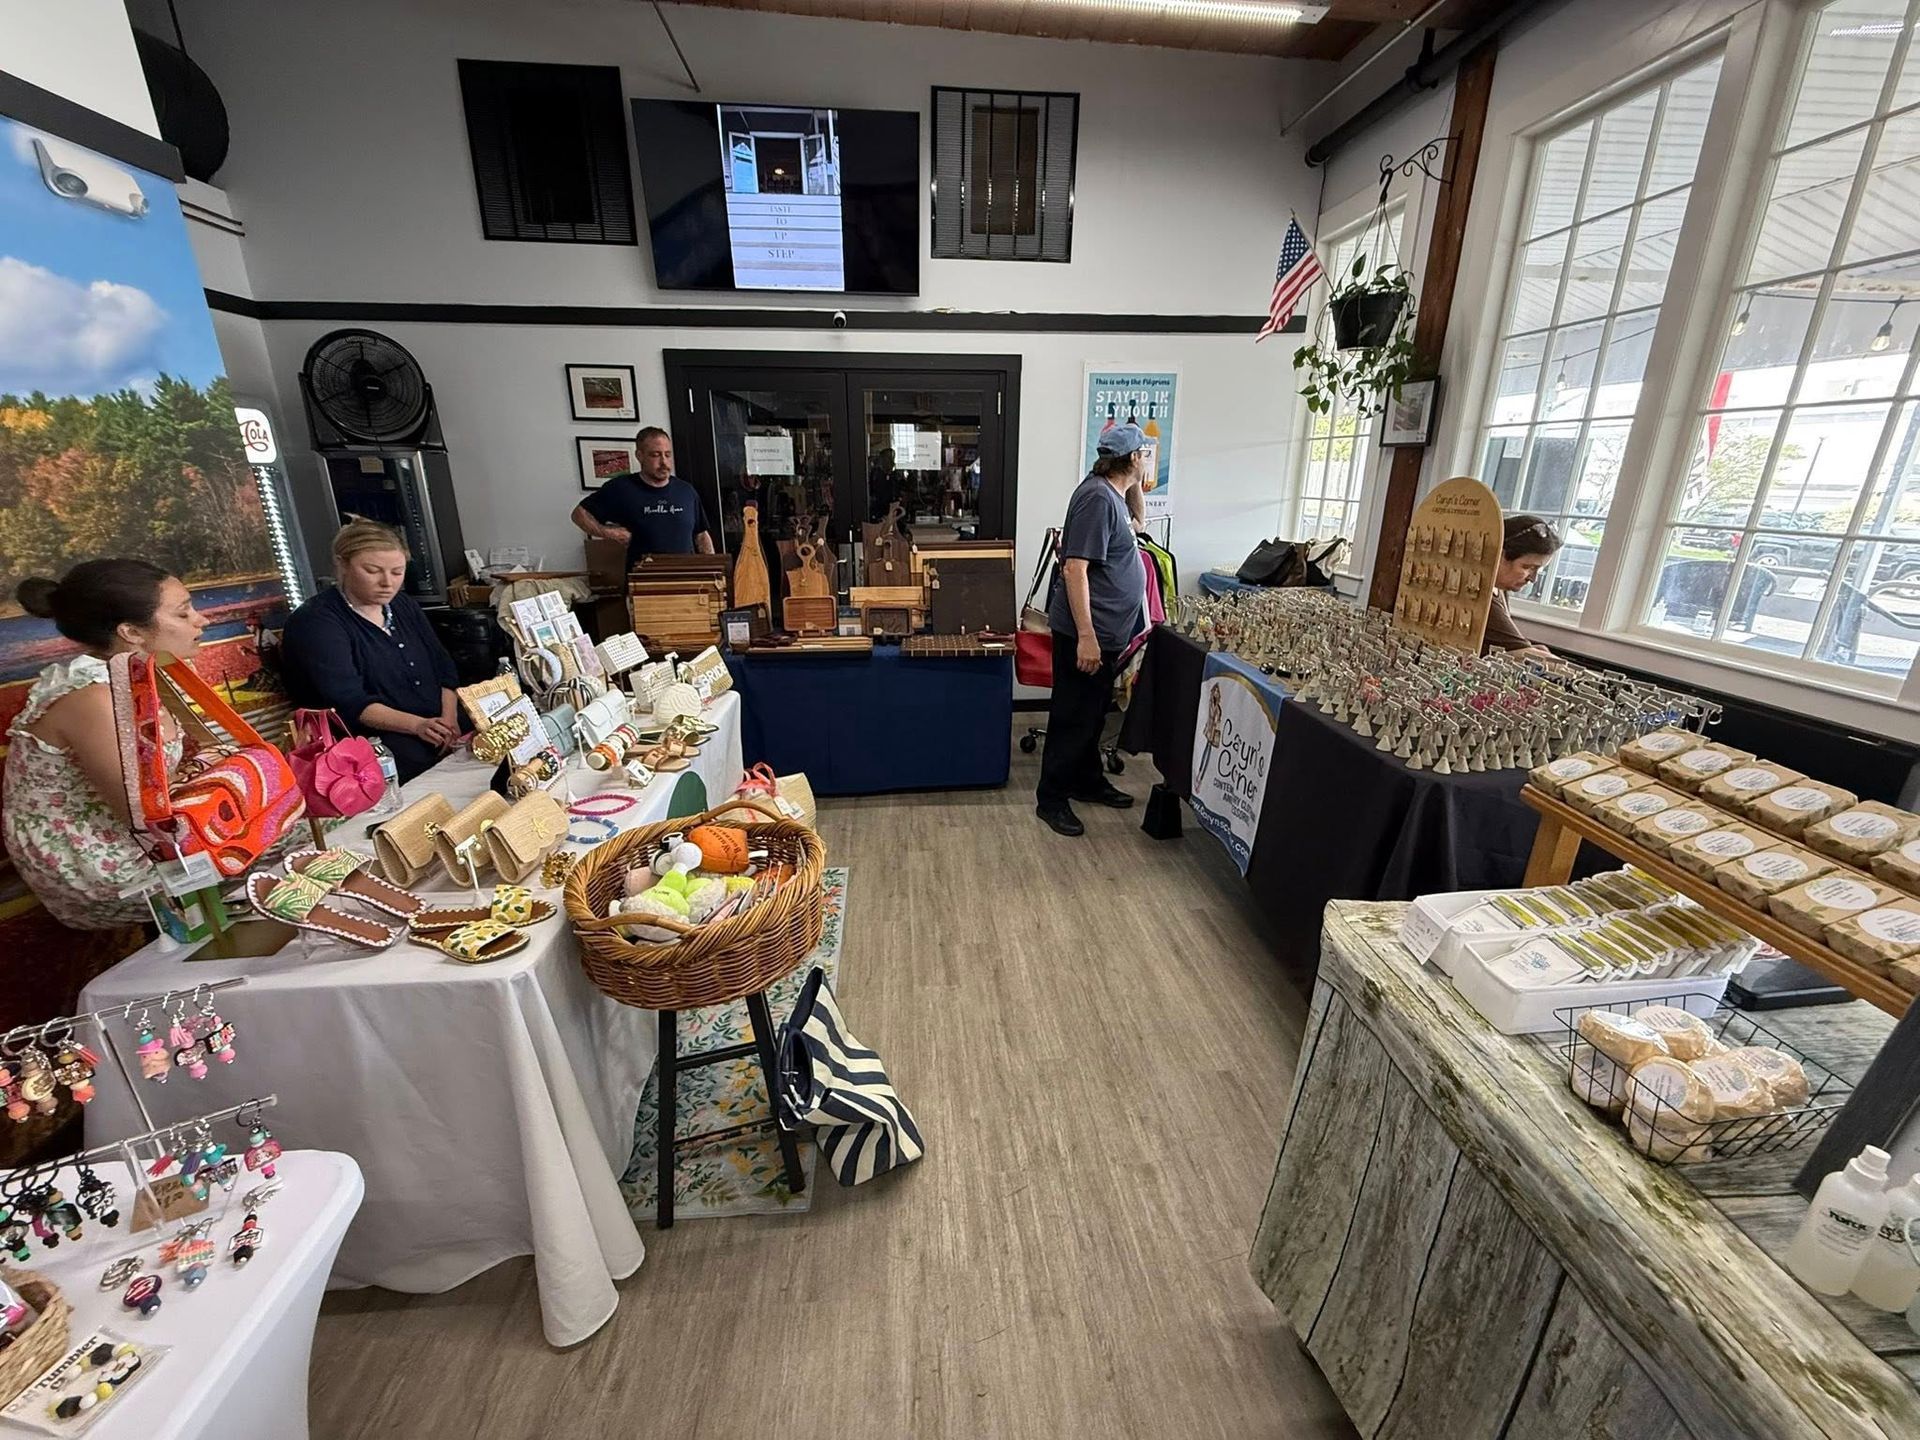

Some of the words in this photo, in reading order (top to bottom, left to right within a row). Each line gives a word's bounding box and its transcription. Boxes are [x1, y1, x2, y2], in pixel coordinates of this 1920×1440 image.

[776, 217, 787, 225] TO
[774, 231, 788, 240] UP
[768, 249, 795, 259] STEP
[1116, 378, 1130, 386] why
[1142, 378, 1170, 387] Pilgrims
[1096, 391, 1149, 403] STAYED
[1155, 391, 1169, 403] IN
[1095, 405, 1168, 418] PLYMOUTH
[35, 1335, 98, 1390] Tumbler
